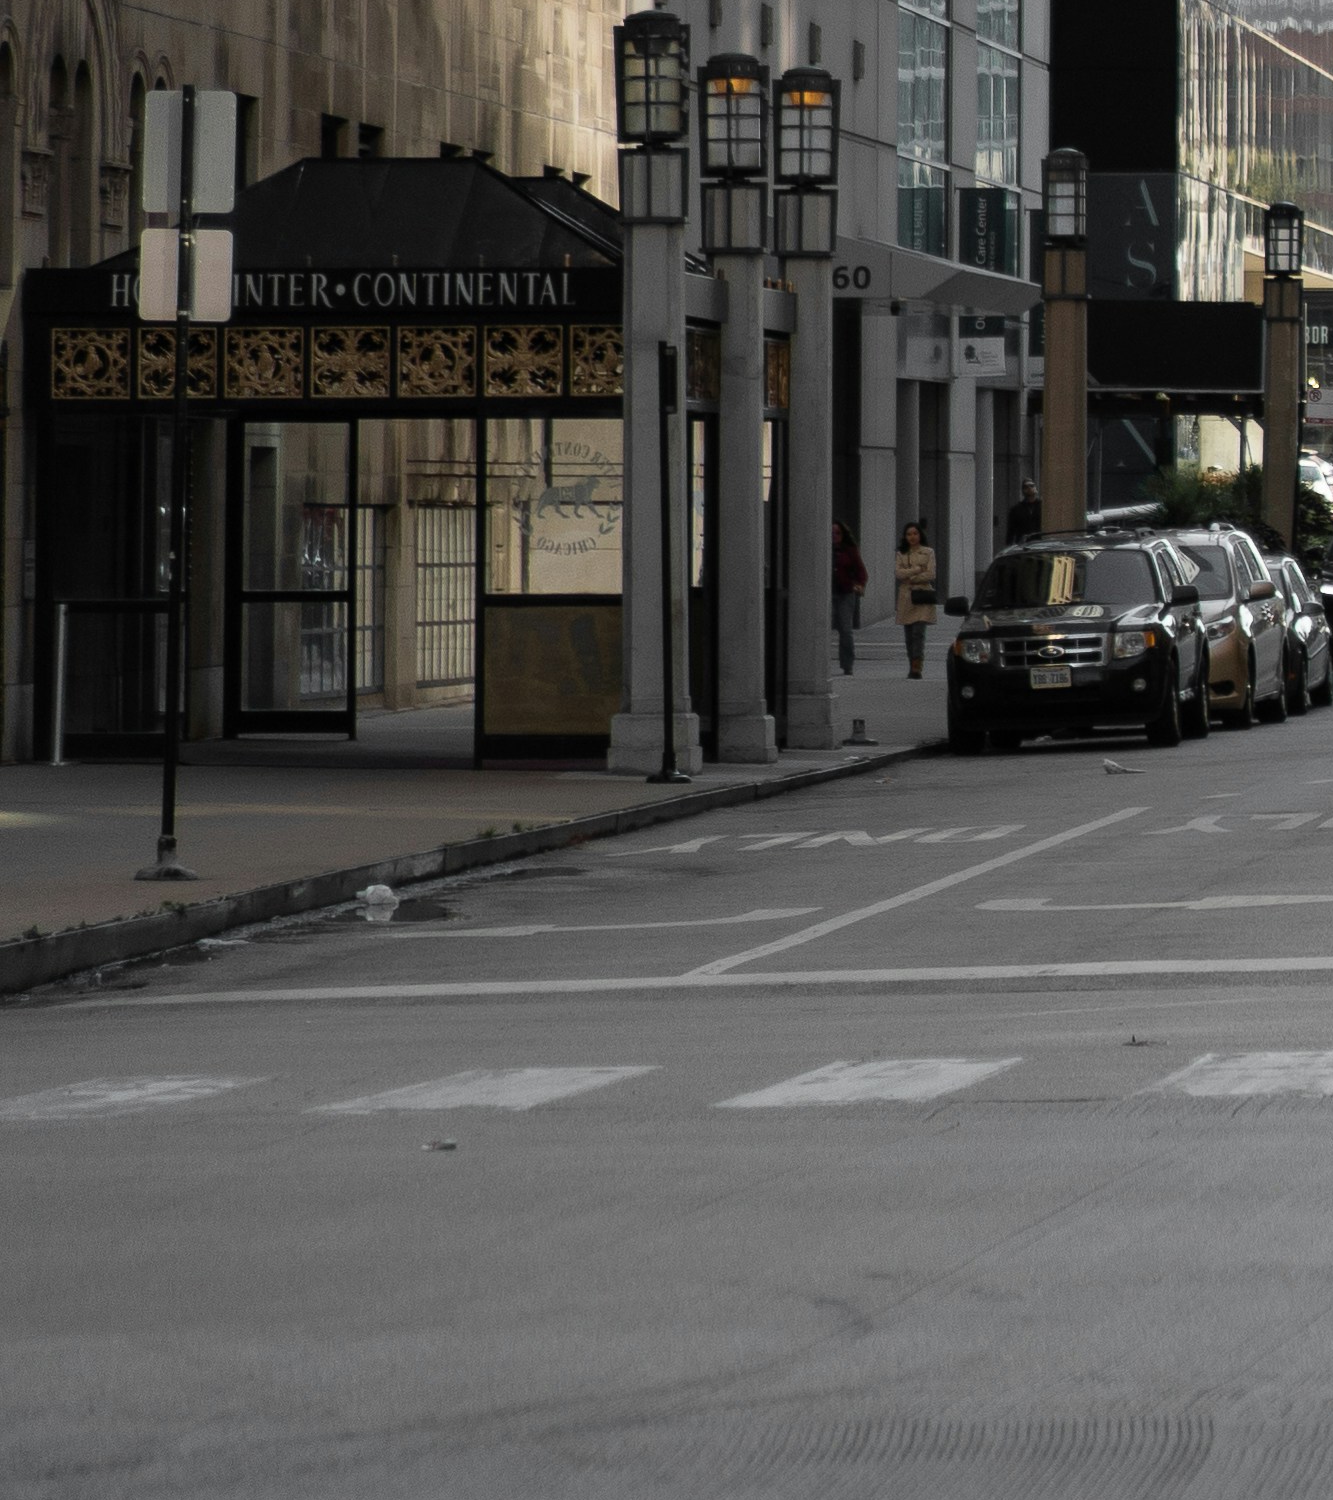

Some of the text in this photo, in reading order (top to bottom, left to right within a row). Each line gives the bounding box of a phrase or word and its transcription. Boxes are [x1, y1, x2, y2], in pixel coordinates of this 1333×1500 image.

[974, 197, 988, 265] Care Center
[832, 265, 872, 290] 60
[605, 824, 1028, 857] ONLY
